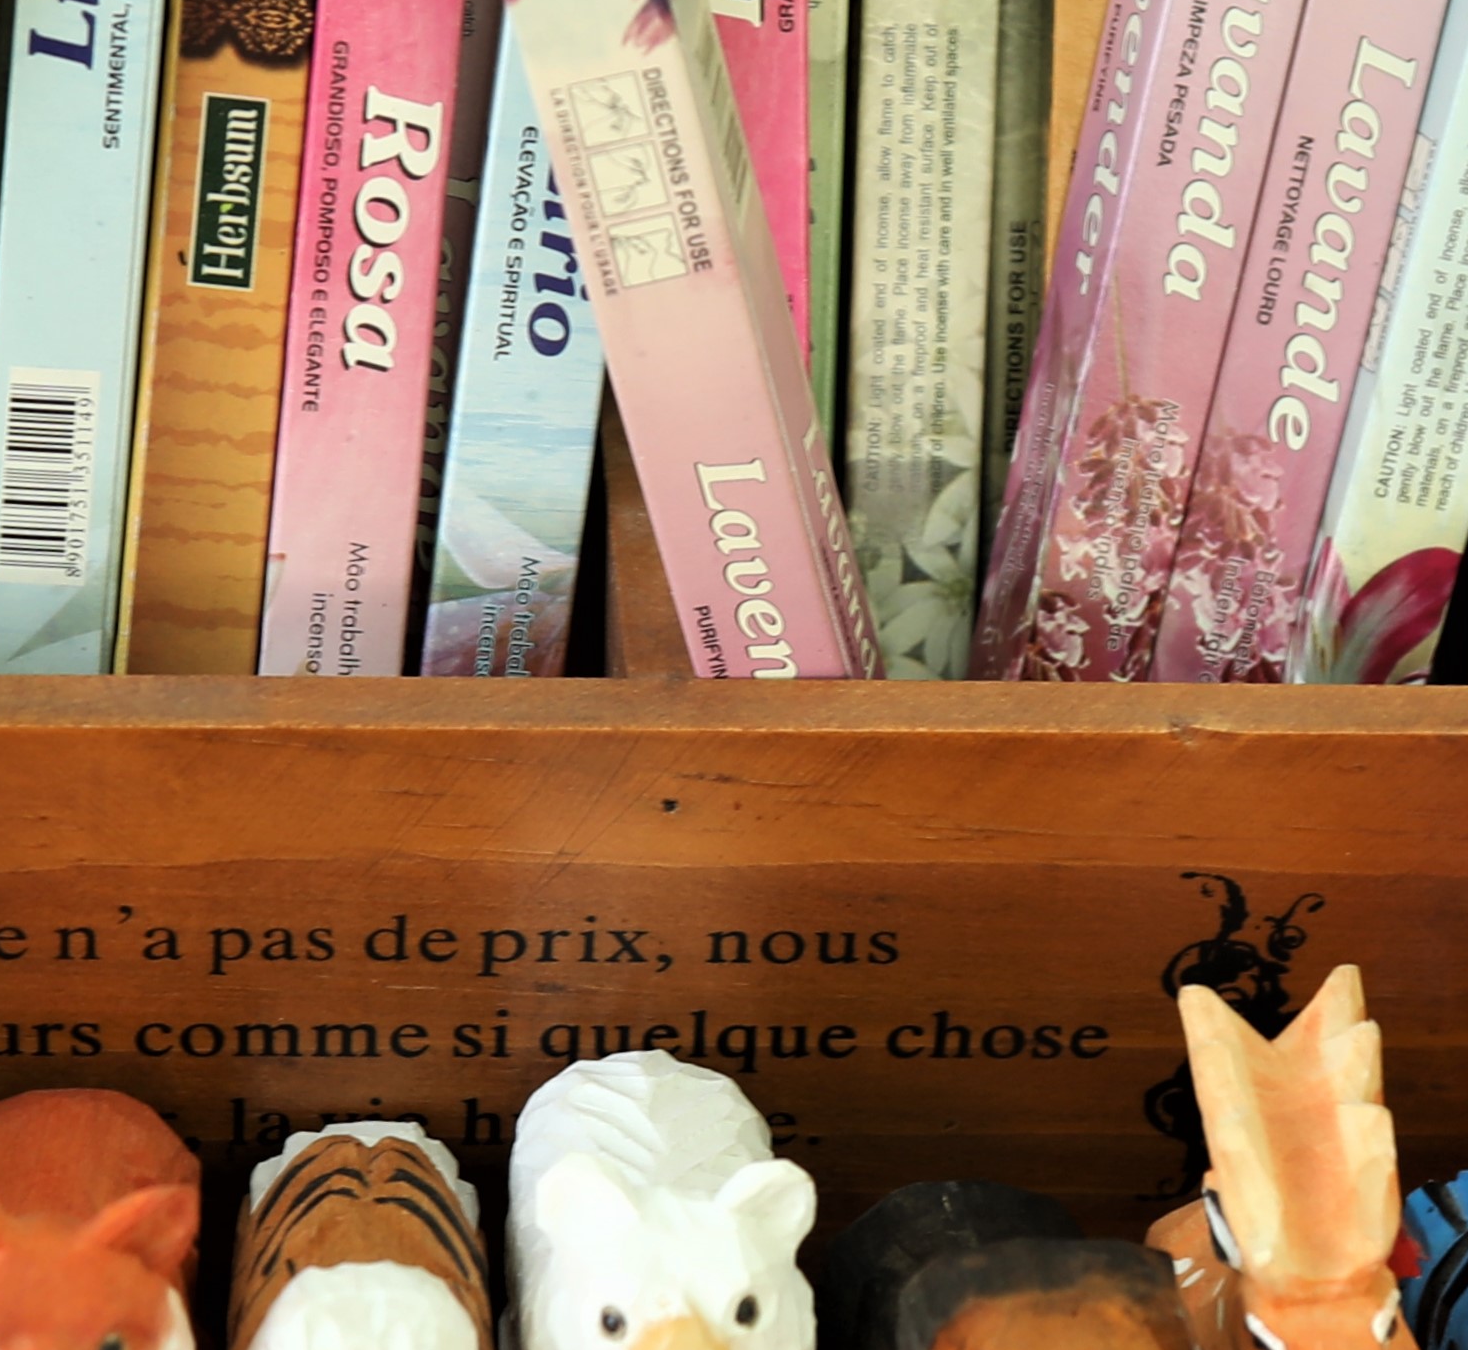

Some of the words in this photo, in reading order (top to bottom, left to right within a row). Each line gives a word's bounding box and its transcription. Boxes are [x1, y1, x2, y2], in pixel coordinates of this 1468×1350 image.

[102, 1, 131, 149] SENTIMENTAL,
[320, 39, 349, 170] GRANDIOSO,
[639, 66, 691, 186] DIRECTIONS
[1156, 82, 1188, 169] PESADA
[200, 106, 258, 279] Herbsum
[506, 125, 541, 232] ELEVAÇÃO
[672, 186, 702, 231] FOR
[1273, 134, 1314, 253] NETTOYAGE
[313, 175, 338, 281] POMPOSO
[336, 85, 446, 374] Rosa
[508, 236, 523, 250] E
[685, 232, 713, 273] USE
[1262, 32, 1420, 458] Lavande
[312, 288, 327, 299] E
[493, 254, 521, 362] SPIRITUAL
[1255, 255, 1286, 326] LOURD
[301, 305, 325, 411] ELEGANTE
[73, 397, 96, 473] 351149
[343, 541, 368, 592] Mão
[304, 592, 332, 674] incenso
[53, 903, 183, 962] n'a
[209, 923, 336, 975] pas
[363, 913, 460, 963] de
[476, 914, 675, 978] prix,
[706, 926, 901, 966] nous
[134, 1019, 431, 1060] comme
[451, 1009, 511, 1059] si
[538, 1009, 859, 1074] quelque
[884, 1011, 1111, 1060] chose
[230, 1098, 280, 1148] la
